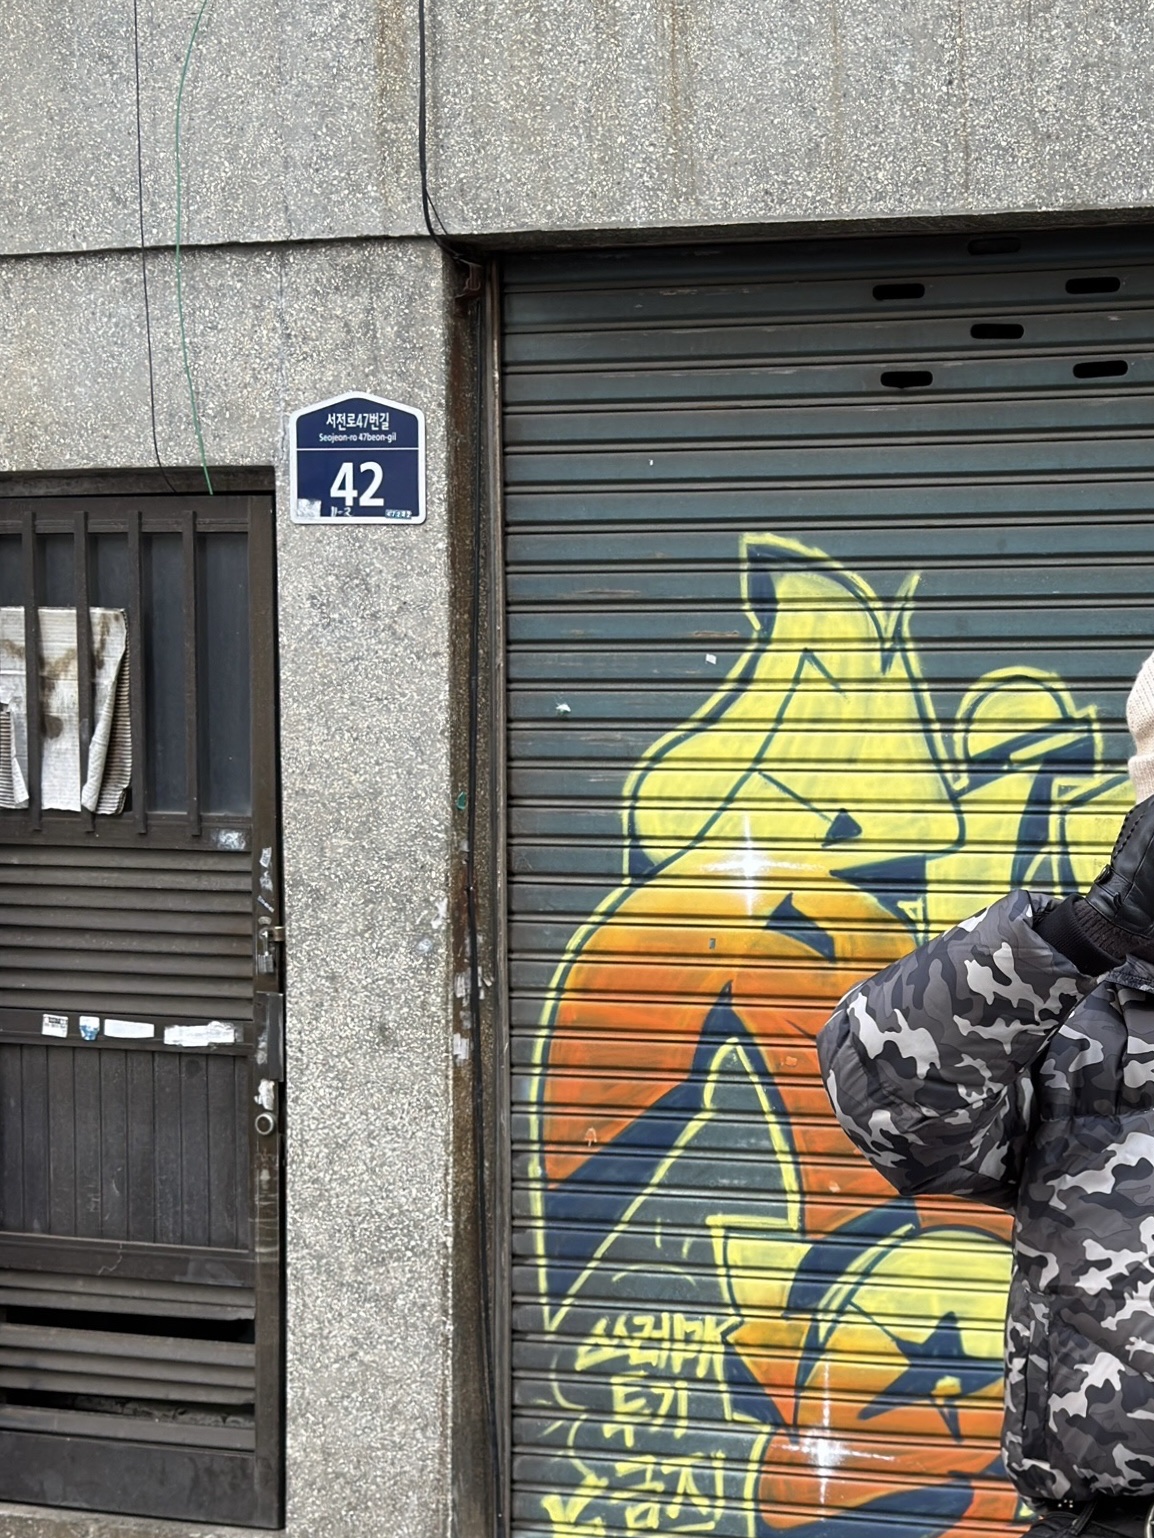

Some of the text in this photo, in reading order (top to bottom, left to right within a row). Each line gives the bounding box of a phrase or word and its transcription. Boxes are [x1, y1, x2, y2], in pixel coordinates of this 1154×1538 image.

[318, 432, 397, 443] Seojeon-ro 47beon-gil
[326, 412, 390, 431] 서전로47번길
[329, 461, 385, 507] 42
[609, 1449, 726, 1536] 금지
